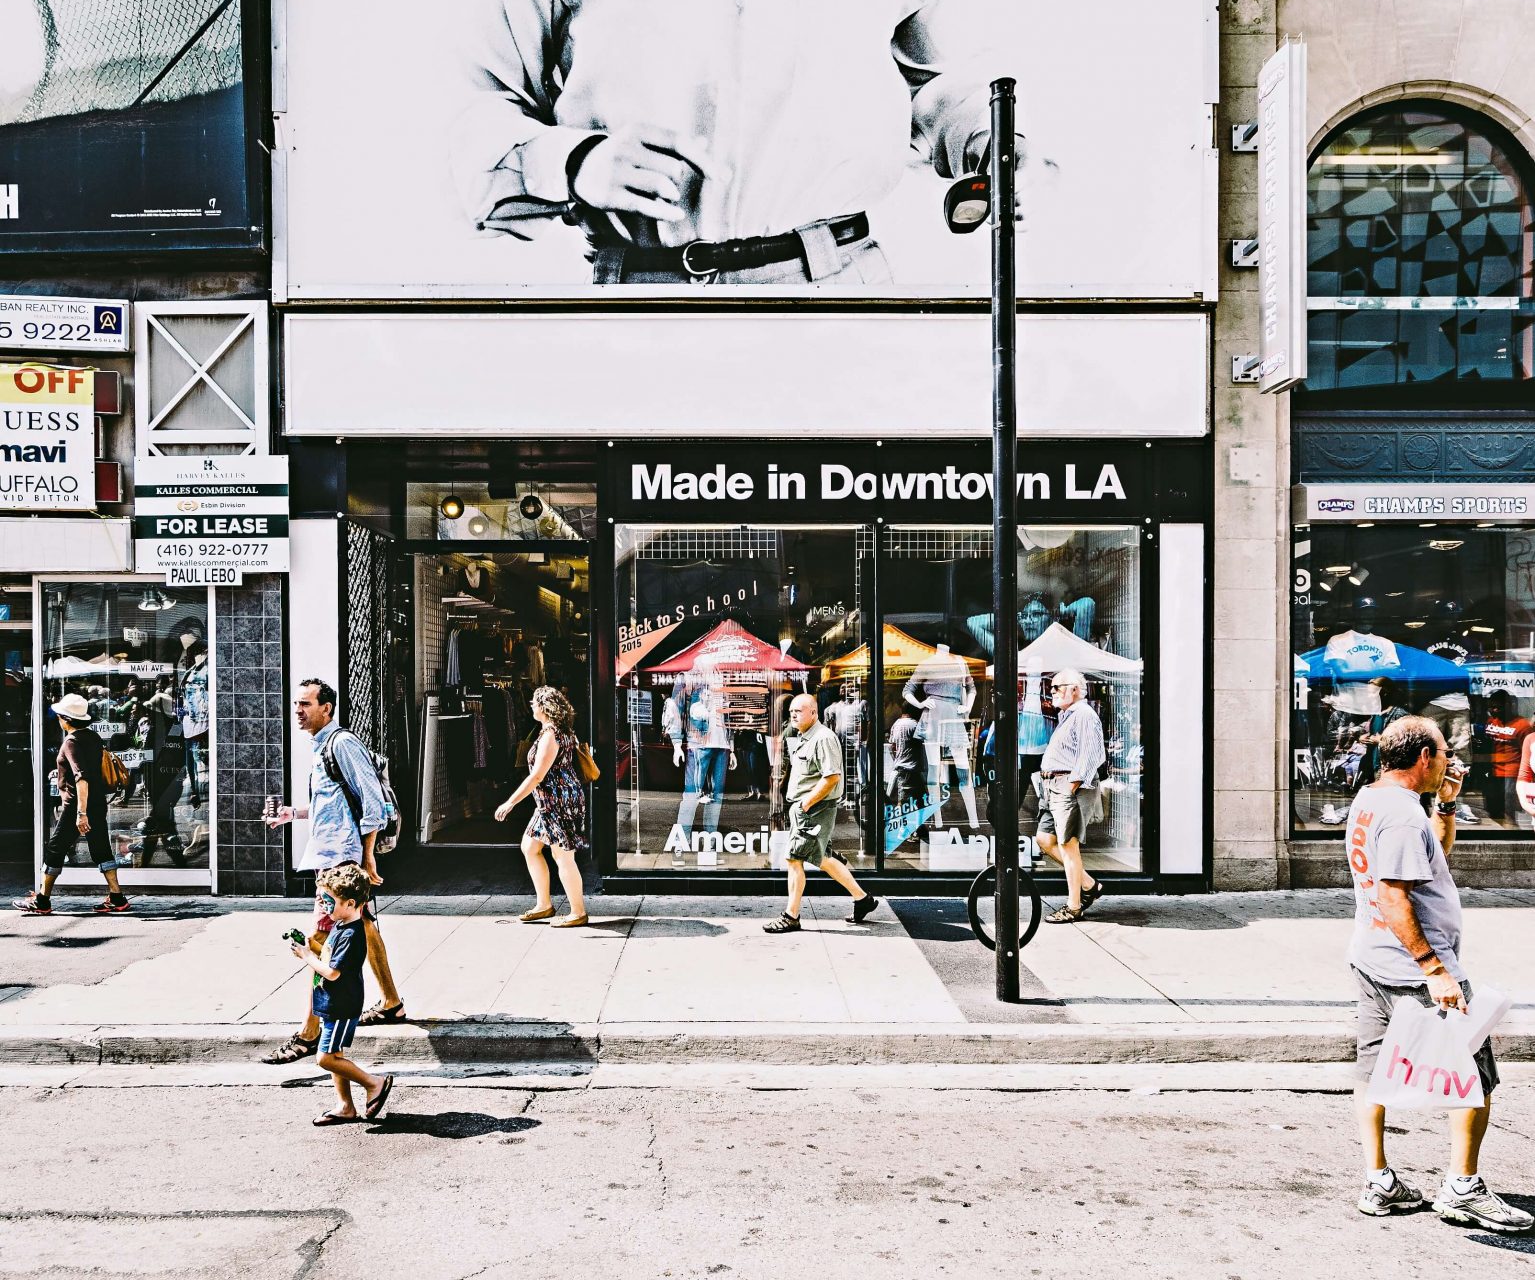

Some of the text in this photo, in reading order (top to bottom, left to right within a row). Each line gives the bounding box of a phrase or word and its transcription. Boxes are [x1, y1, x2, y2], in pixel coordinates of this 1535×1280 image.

[25, 303, 64, 313] REALTY
[67, 305, 89, 314] INC.
[23, 322, 91, 342] 9222
[14, 368, 85, 394] OFF
[0, 440, 66, 463] mavi
[631, 463, 754, 500] Made
[768, 463, 806, 500] in
[1065, 463, 1127, 500] LA
[34, 494, 79, 502] BITTON
[156, 486, 259, 495] KALLES COMMERCIAL
[1319, 500, 1354, 509] CHAMPS
[1364, 497, 1528, 513] CHAMPS SPORTS
[156, 518, 268, 534] FOR LEASE
[156, 543, 269, 558] (416) 922-0777
[157, 559, 269, 567] www.kallescommercial.com
[171, 568, 236, 583] PAUL LEBO
[618, 580, 757, 642] Back to School
[813, 605, 845, 616] MEN'S
[621, 638, 642, 654] 2015
[1346, 644, 1383, 657] TORONTO
[130, 664, 165, 673] MAVI AVE
[90, 724, 109, 733] SILVER
[884, 796, 918, 821] Back
[663, 823, 772, 854] Ameri
[1387, 1045, 1477, 1098] hmv
